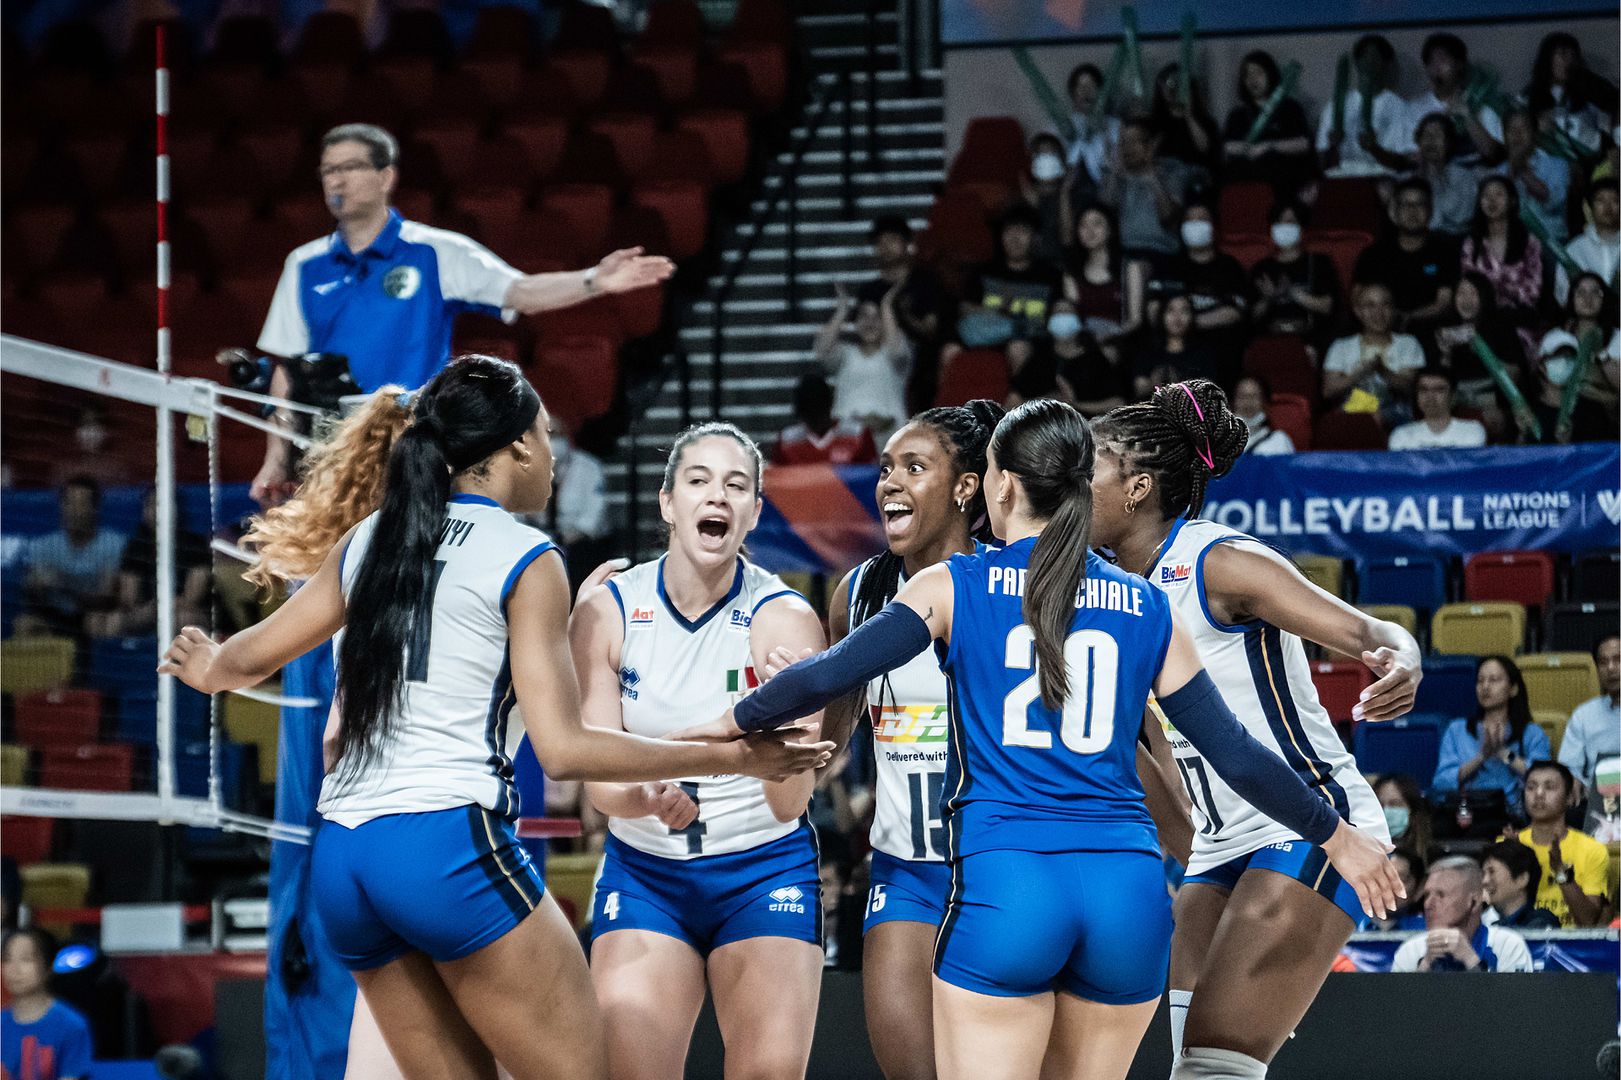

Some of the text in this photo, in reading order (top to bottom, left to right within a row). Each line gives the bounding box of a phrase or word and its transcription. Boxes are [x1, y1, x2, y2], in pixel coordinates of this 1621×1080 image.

[1483, 490, 1570, 510] NATIONS
[1483, 509, 1560, 530] LEAGUE
[988, 566, 1144, 617] PACHIALE
[1002, 624, 1119, 755] 20
[886, 751, 926, 762] Delivered
[1176, 756, 1224, 835] 17
[603, 891, 620, 921] 4
